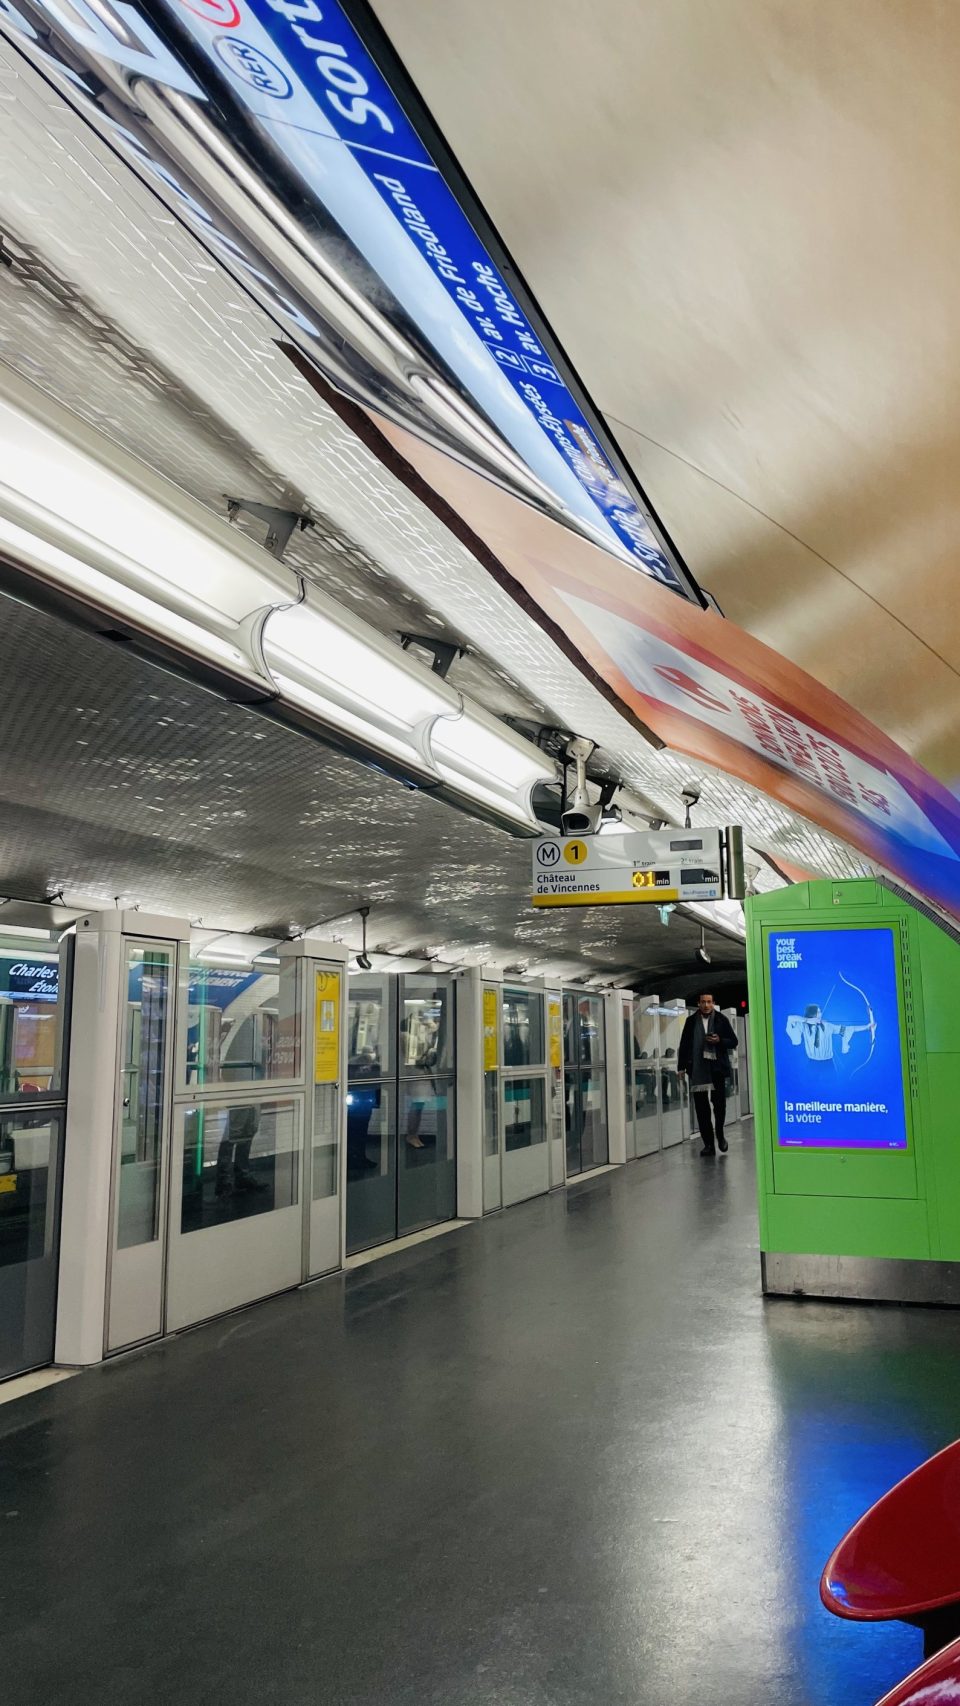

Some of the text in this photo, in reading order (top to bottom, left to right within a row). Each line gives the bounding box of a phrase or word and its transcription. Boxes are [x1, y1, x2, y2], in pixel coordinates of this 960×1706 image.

[233, 44, 279, 92] RER
[374, 173, 520, 367] 2 av. de Friedland
[471, 261, 558, 381] 3 av. Hoche
[537, 873, 576, 884] Château
[632, 870, 656, 888] 01
[656, 878, 670, 886] min
[704, 875, 719, 883] min
[537, 882, 600, 894] de Vincennes
[776, 938, 796, 946] your
[776, 945, 796, 954] best
[776, 952, 803, 962] break
[776, 960, 798, 969] .com
[8, 963, 58, 979] Charles
[784, 1100, 889, 1114] la meilleure manière,
[785, 1112, 822, 1124] la vôtre
